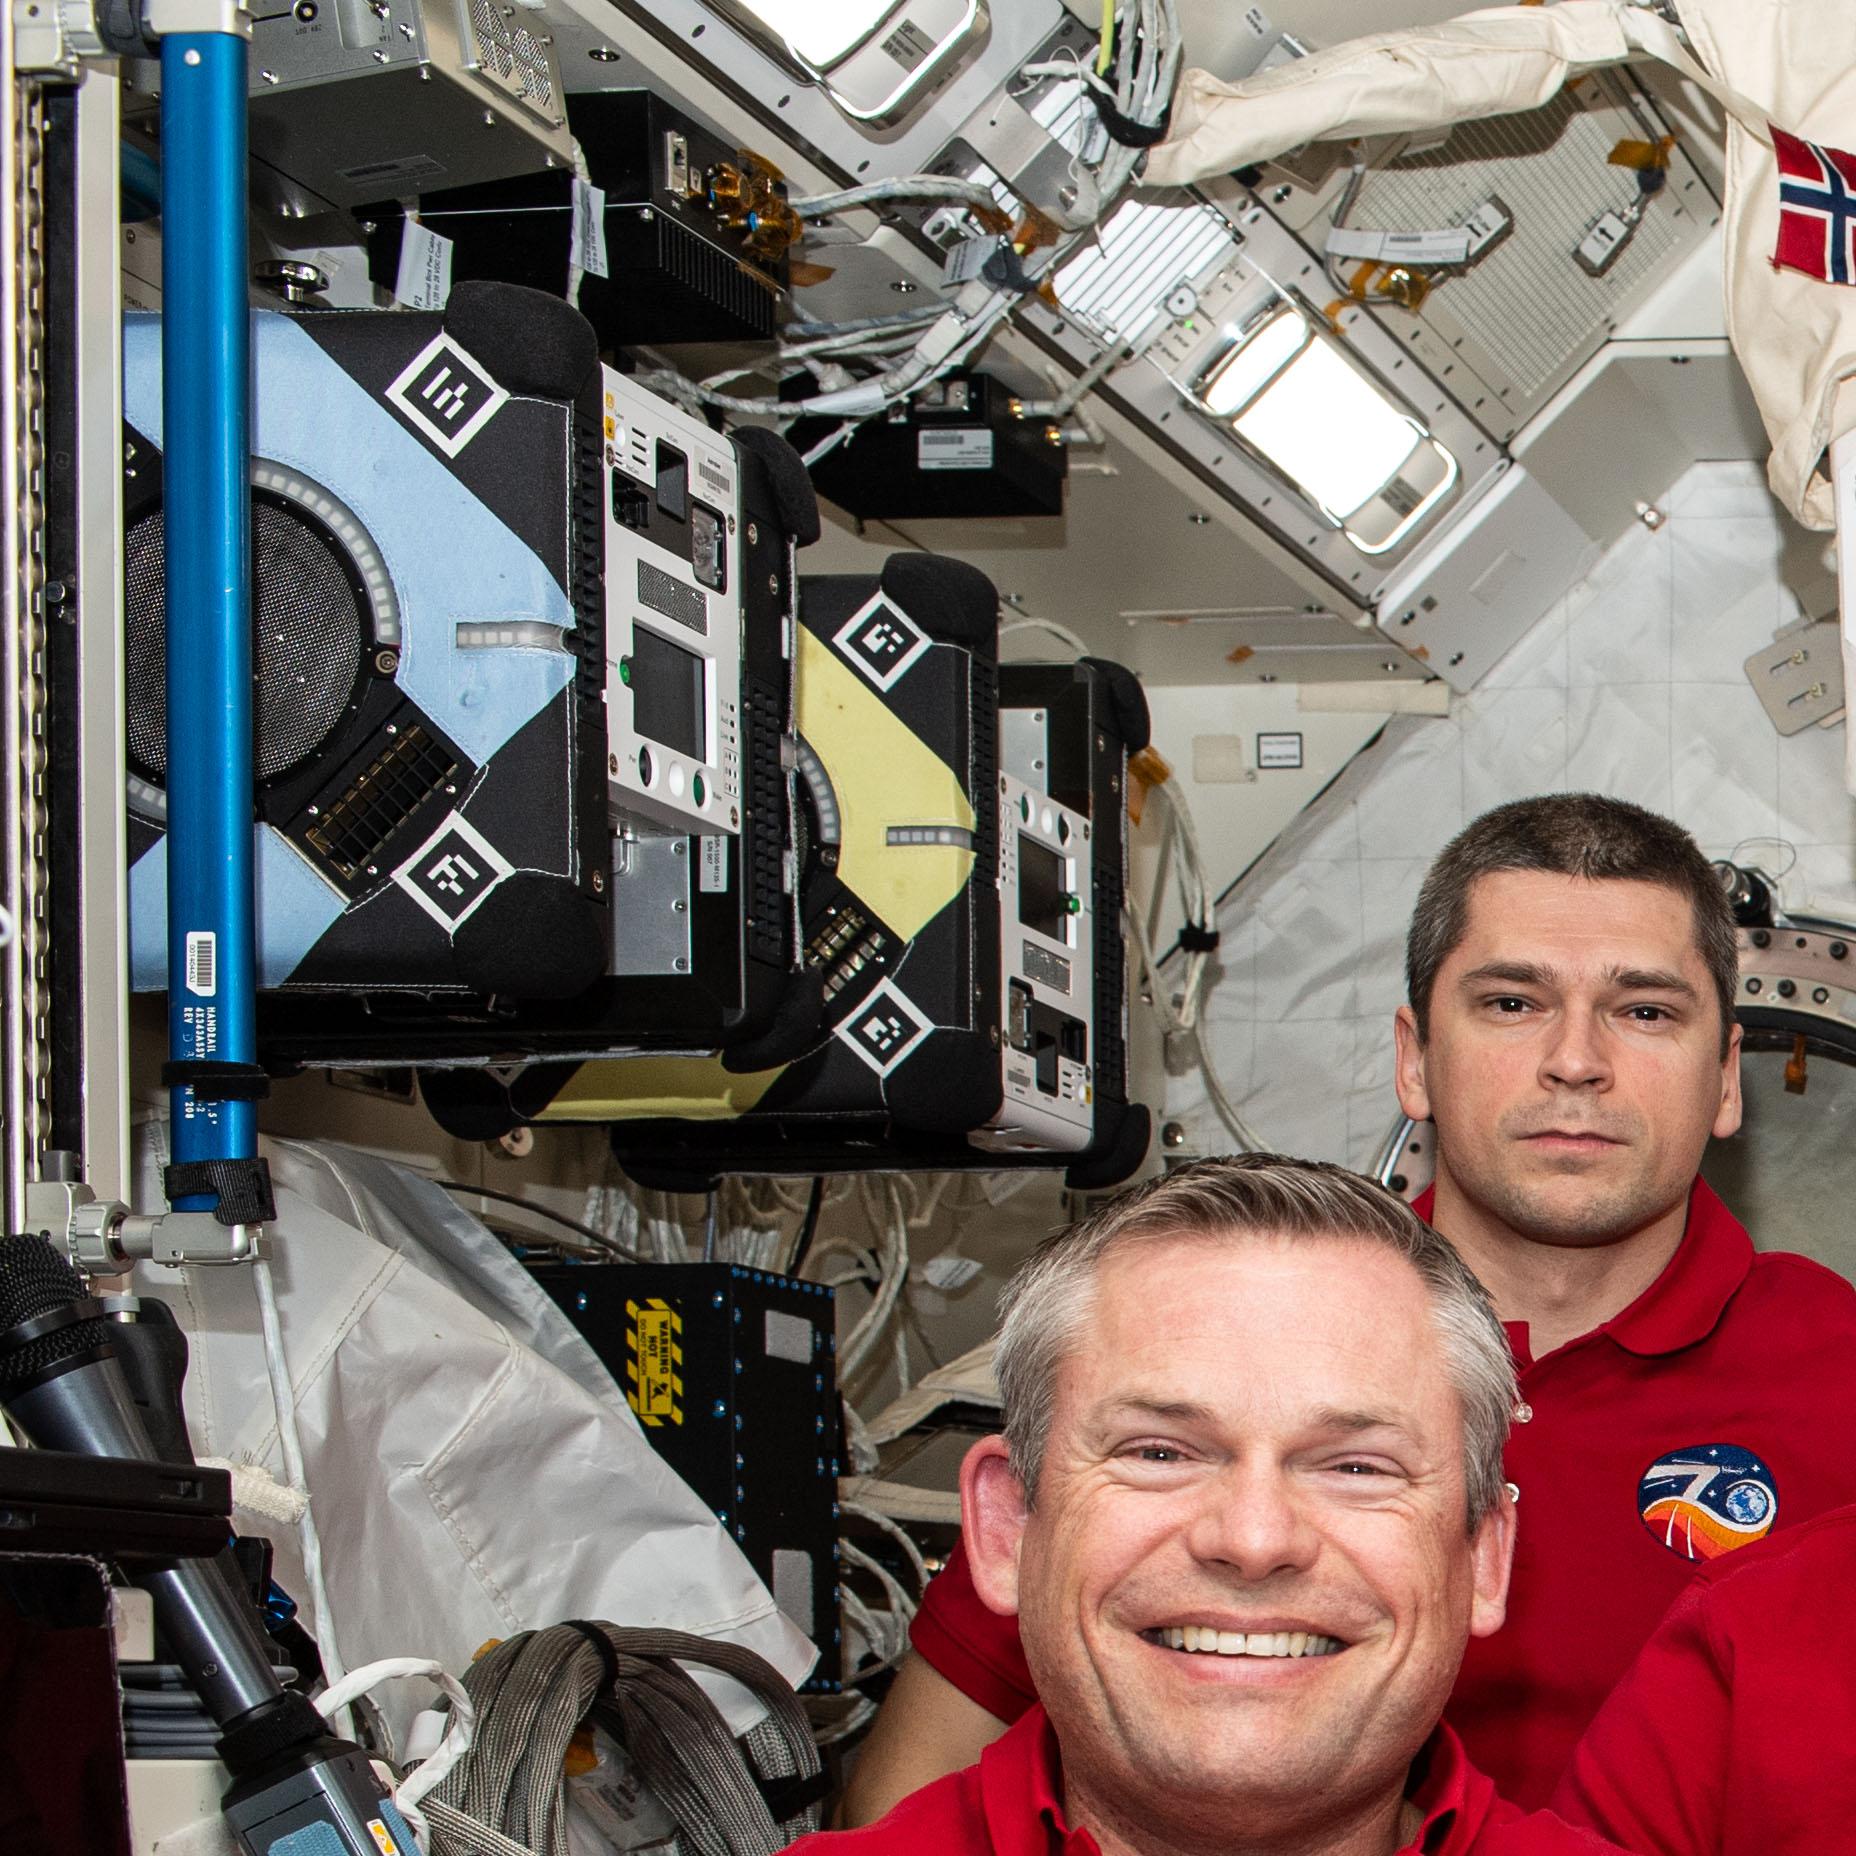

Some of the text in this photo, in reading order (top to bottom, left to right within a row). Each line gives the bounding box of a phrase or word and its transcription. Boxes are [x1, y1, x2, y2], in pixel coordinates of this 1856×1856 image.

[184, 1007, 192, 1023] REV
[206, 1006, 215, 1052] HANDRAIL
[640, 1318, 646, 1328] DO
[648, 1335, 656, 1358] HOT
[659, 1320, 668, 1374] WARNING
